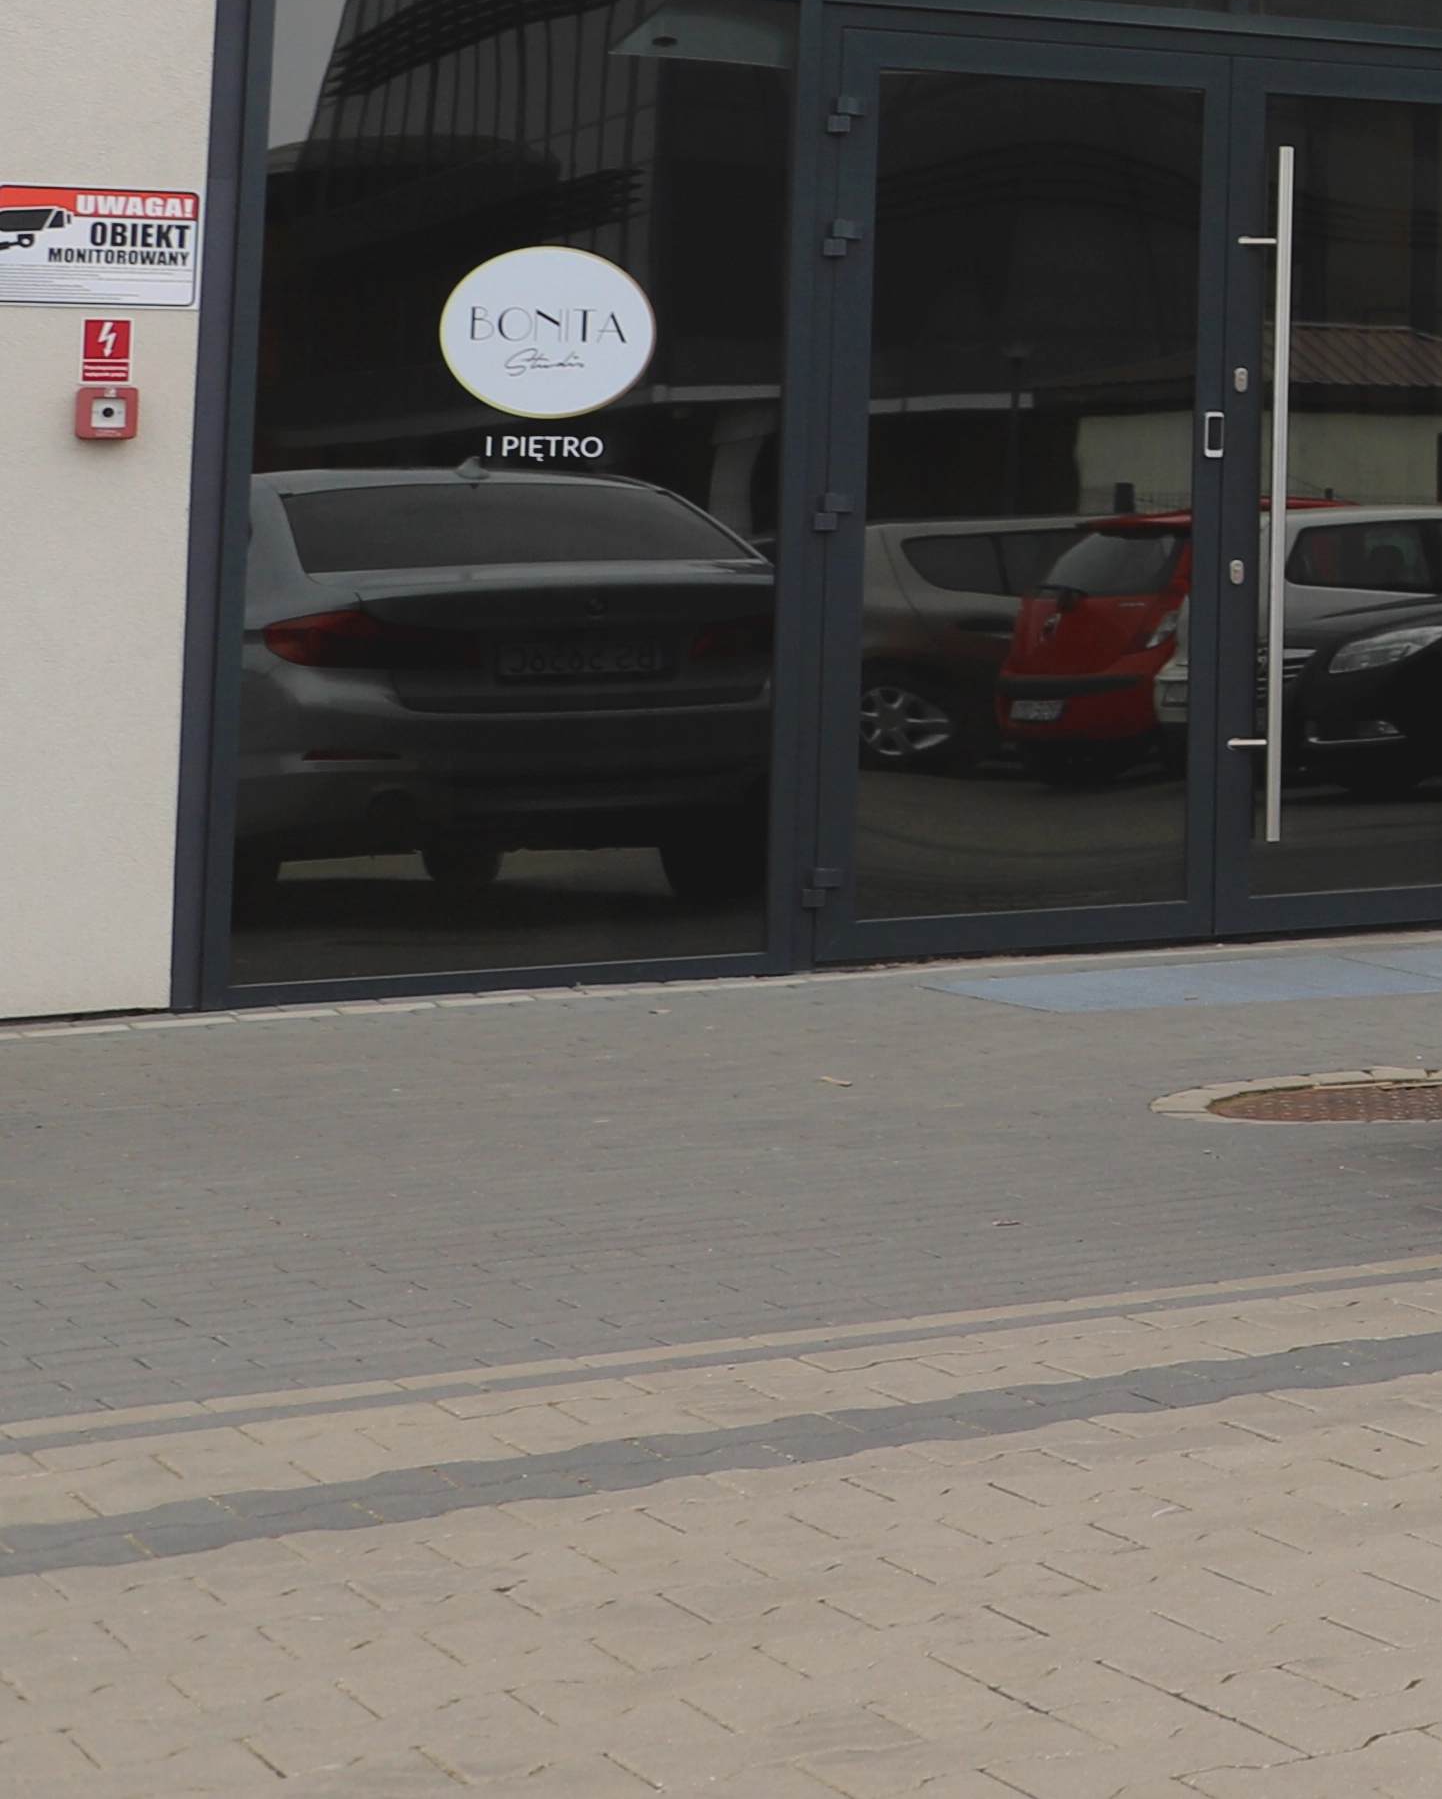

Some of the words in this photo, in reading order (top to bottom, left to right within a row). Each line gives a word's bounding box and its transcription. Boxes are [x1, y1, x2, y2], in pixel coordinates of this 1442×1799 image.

[76, 194, 195, 218] UWAGA!
[90, 221, 191, 249] OBIEKT
[48, 247, 190, 267] MONITOROWANY
[470, 305, 627, 344] BONITA
[485, 435, 493, 458] I
[501, 435, 604, 462] PIĘTRO
